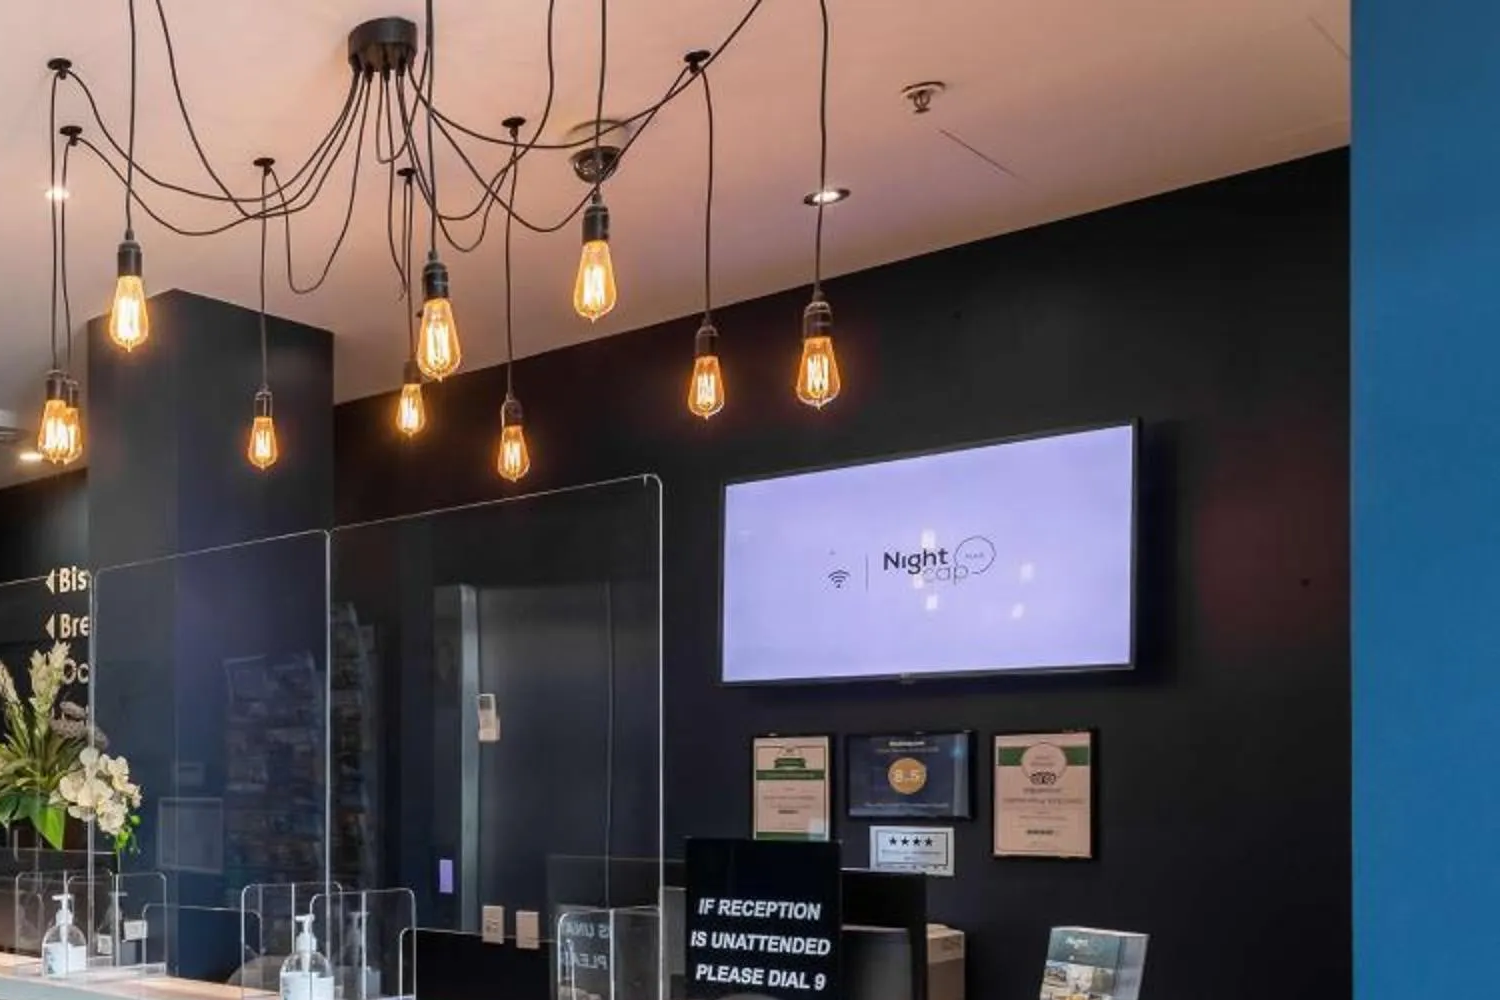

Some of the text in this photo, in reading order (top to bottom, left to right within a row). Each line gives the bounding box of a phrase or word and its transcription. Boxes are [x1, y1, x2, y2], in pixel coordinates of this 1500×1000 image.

[883, 547, 948, 575] Night
[923, 565, 969, 586] cap
[698, 898, 821, 920] IF RECEPTION
[690, 930, 831, 956] IS UNATTENDED
[695, 963, 827, 991] PLEASE DIAL 9
